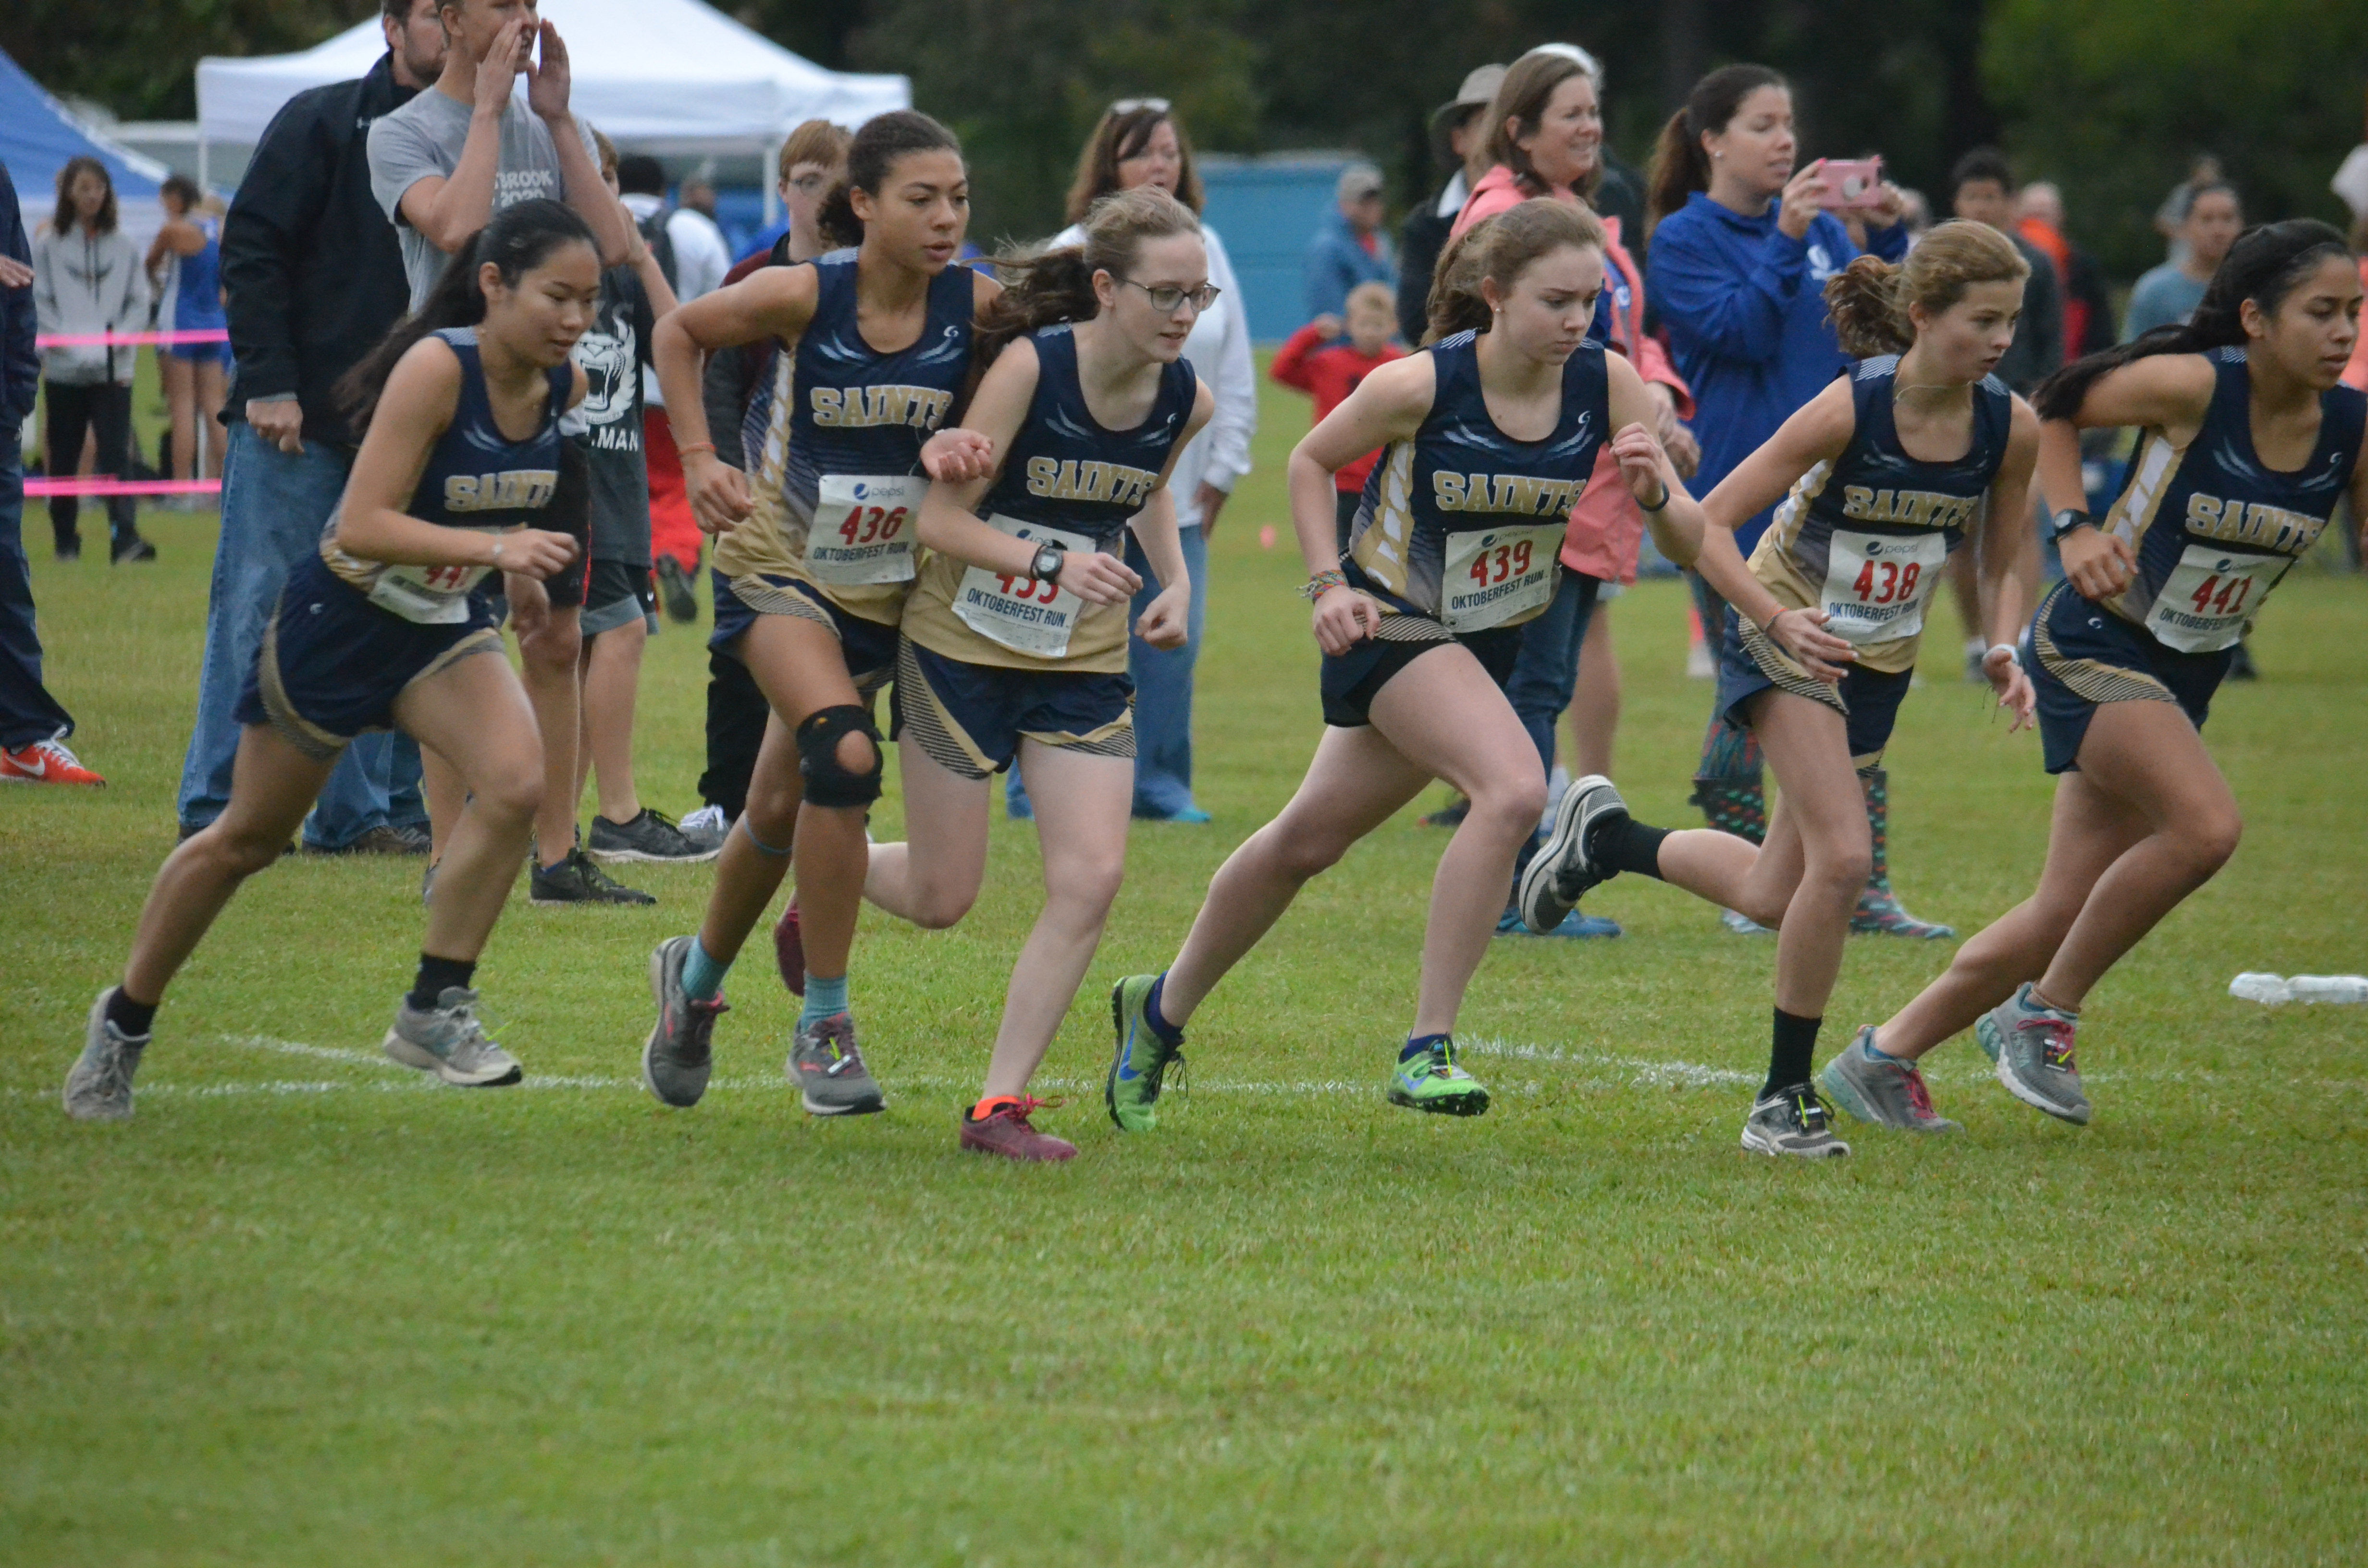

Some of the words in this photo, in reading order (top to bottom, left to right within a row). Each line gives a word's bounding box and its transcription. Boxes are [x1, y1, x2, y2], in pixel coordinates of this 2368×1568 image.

[810, 384, 953, 431] SAINTS
[1027, 456, 1159, 506] SAINTS
[1433, 470, 1587, 518] SAINTS
[839, 506, 908, 545] 436
[1843, 485, 1979, 527] SAINTS
[2185, 492, 2327, 555] SAINTS
[887, 541, 909, 555] RUN
[1470, 539, 1533, 588] 439
[1451, 578, 1522, 610] OKTOBERFEST
[1523, 570, 1544, 587] RUN
[1853, 560, 1921, 604] 438
[2190, 574, 2254, 615] 441
[967, 588, 1044, 623] OKTOBERFEST
[1044, 610, 1067, 627] RUN
[1829, 602, 1899, 621] OKTOBERFEST
[1900, 598, 1919, 616] RUN
